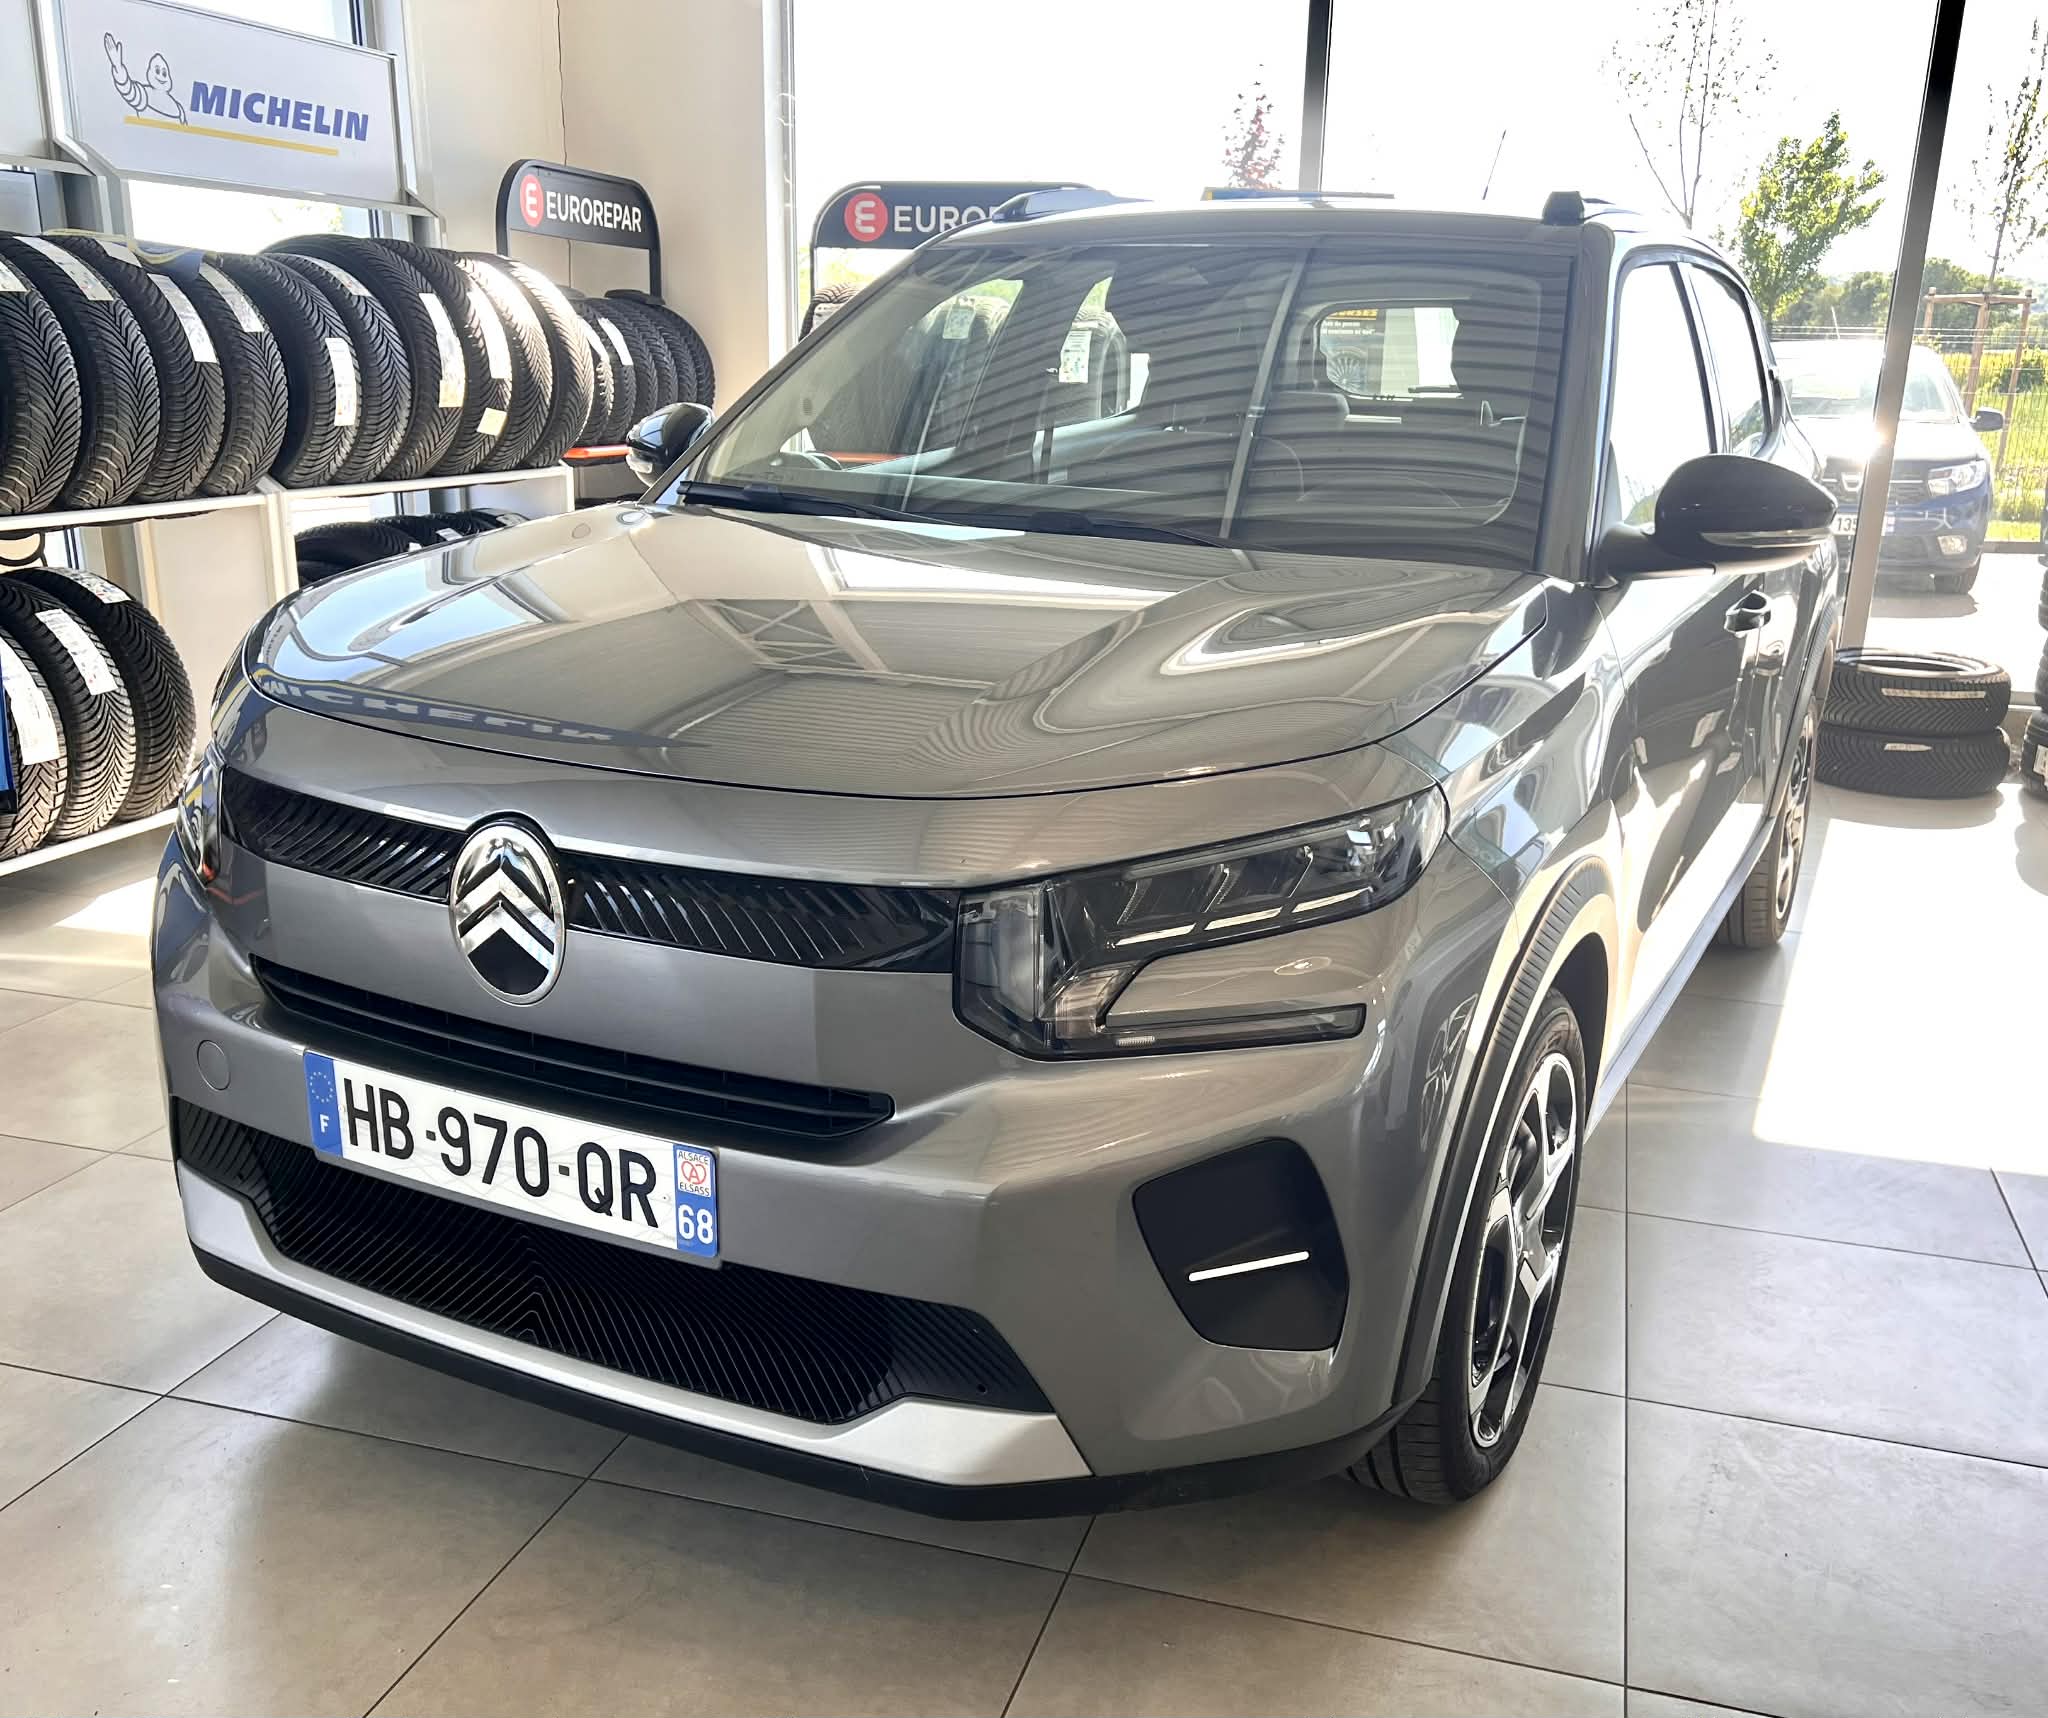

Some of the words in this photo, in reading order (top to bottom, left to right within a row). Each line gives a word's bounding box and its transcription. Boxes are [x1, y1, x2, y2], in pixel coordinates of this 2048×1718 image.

[190, 81, 369, 141] MICHELIN
[546, 191, 642, 233] EUROREPAR
[894, 205, 1000, 233] EURO
[319, 1114, 330, 1133] F
[343, 1078, 659, 1228] HB-970-QR
[678, 1151, 709, 1165] ALSACE
[679, 1181, 710, 1197] ELSASS
[678, 1203, 714, 1245] 68
